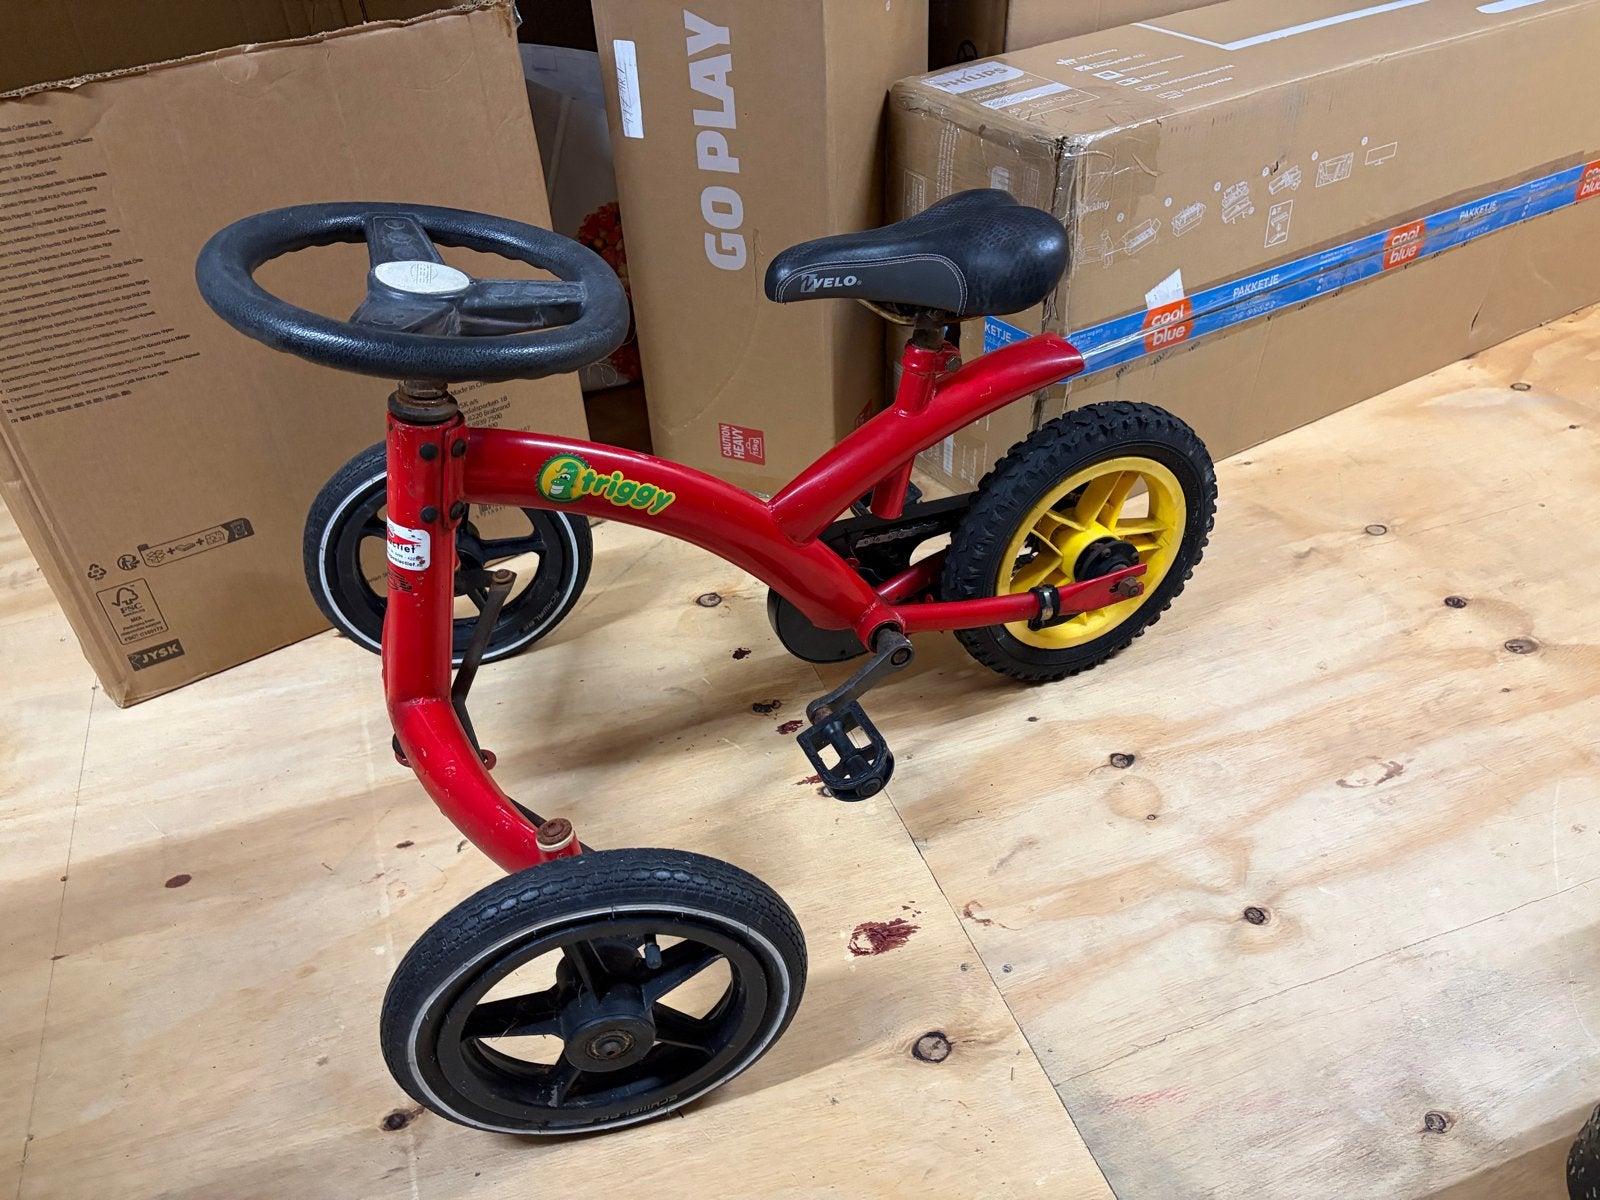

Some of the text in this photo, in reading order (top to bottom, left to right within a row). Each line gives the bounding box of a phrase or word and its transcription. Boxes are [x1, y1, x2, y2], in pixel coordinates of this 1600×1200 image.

[936, 67, 1008, 89] PHILIPS
[683, 9, 747, 271] GO PLAY
[1391, 225, 1420, 246] cool
[1389, 246, 1416, 264] blue
[812, 275, 858, 289] VELO
[1232, 273, 1280, 299] PAKKETJE
[1152, 304, 1184, 327] cool
[1152, 327, 1186, 347] blue
[720, 424, 732, 457] CAUTION
[731, 426, 745, 459] HEAVY
[581, 471, 673, 514] triggy
[142, 644, 178, 664] JYSK
